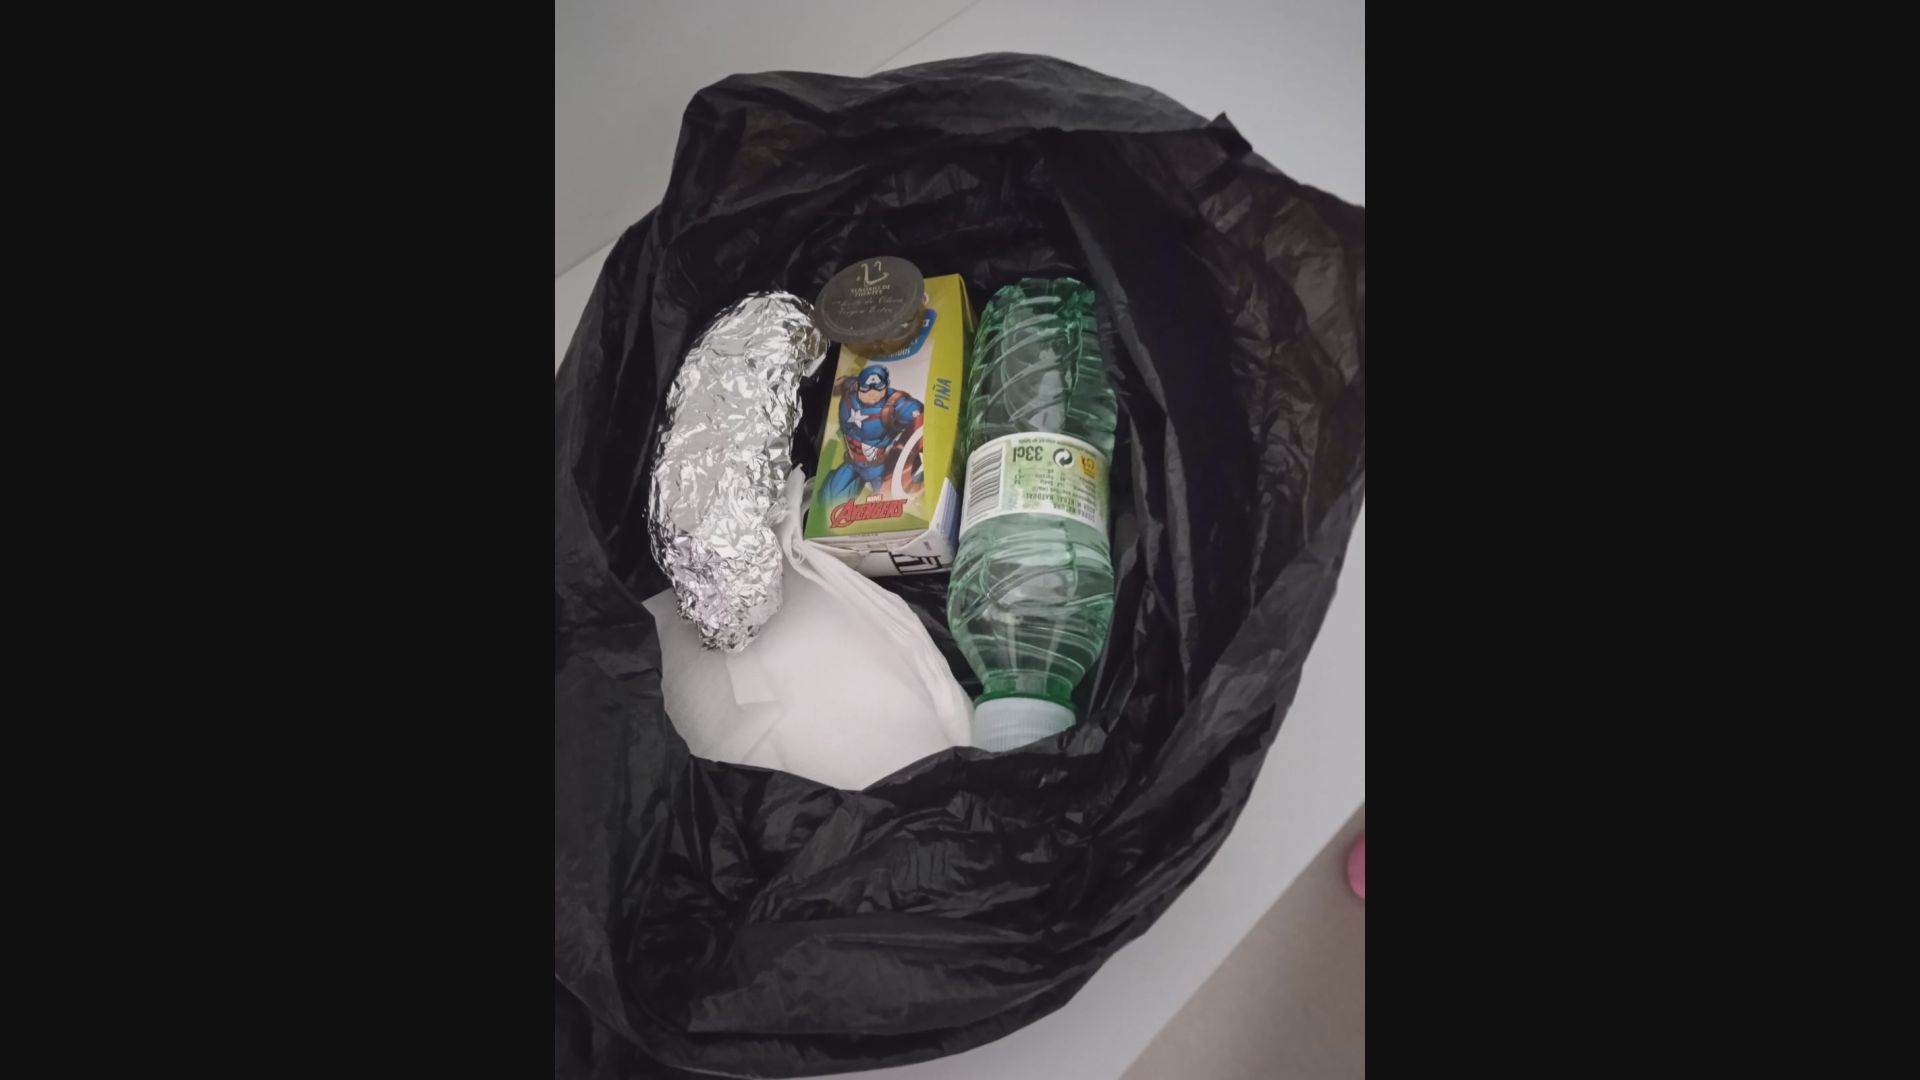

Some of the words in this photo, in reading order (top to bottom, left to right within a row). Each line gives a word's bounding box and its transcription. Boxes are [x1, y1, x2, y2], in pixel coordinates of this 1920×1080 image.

[932, 377, 952, 410] PIÑA
[1012, 446, 1043, 462] 33cl
[830, 498, 907, 528] AVENGERS
